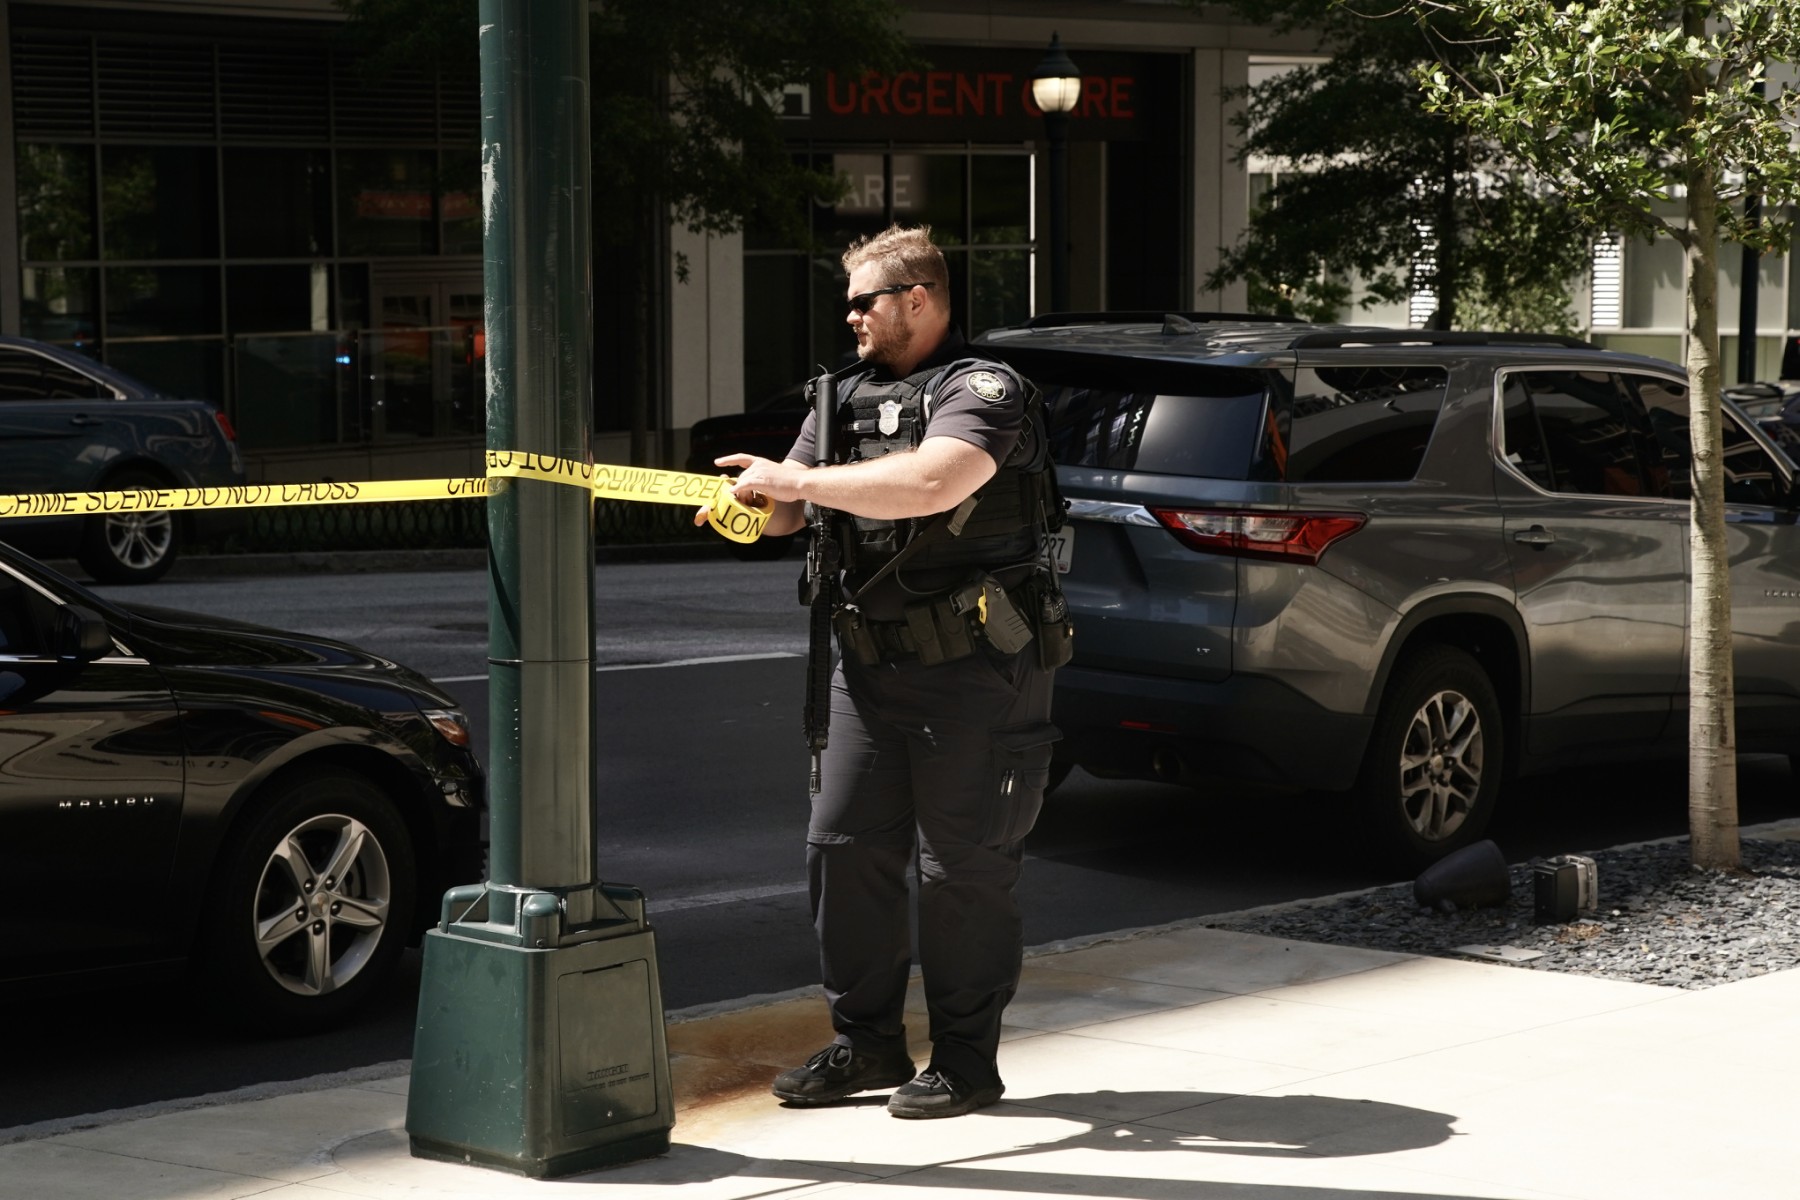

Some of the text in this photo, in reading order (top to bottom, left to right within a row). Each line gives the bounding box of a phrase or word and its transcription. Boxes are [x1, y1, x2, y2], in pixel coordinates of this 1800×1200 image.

[826, 69, 1013, 118] URGENT
[1020, 75, 1136, 119] CRE
[715, 504, 768, 538] NOT
[1040, 536, 1066, 560] 227
[58, 796, 155, 809] MALIBU
